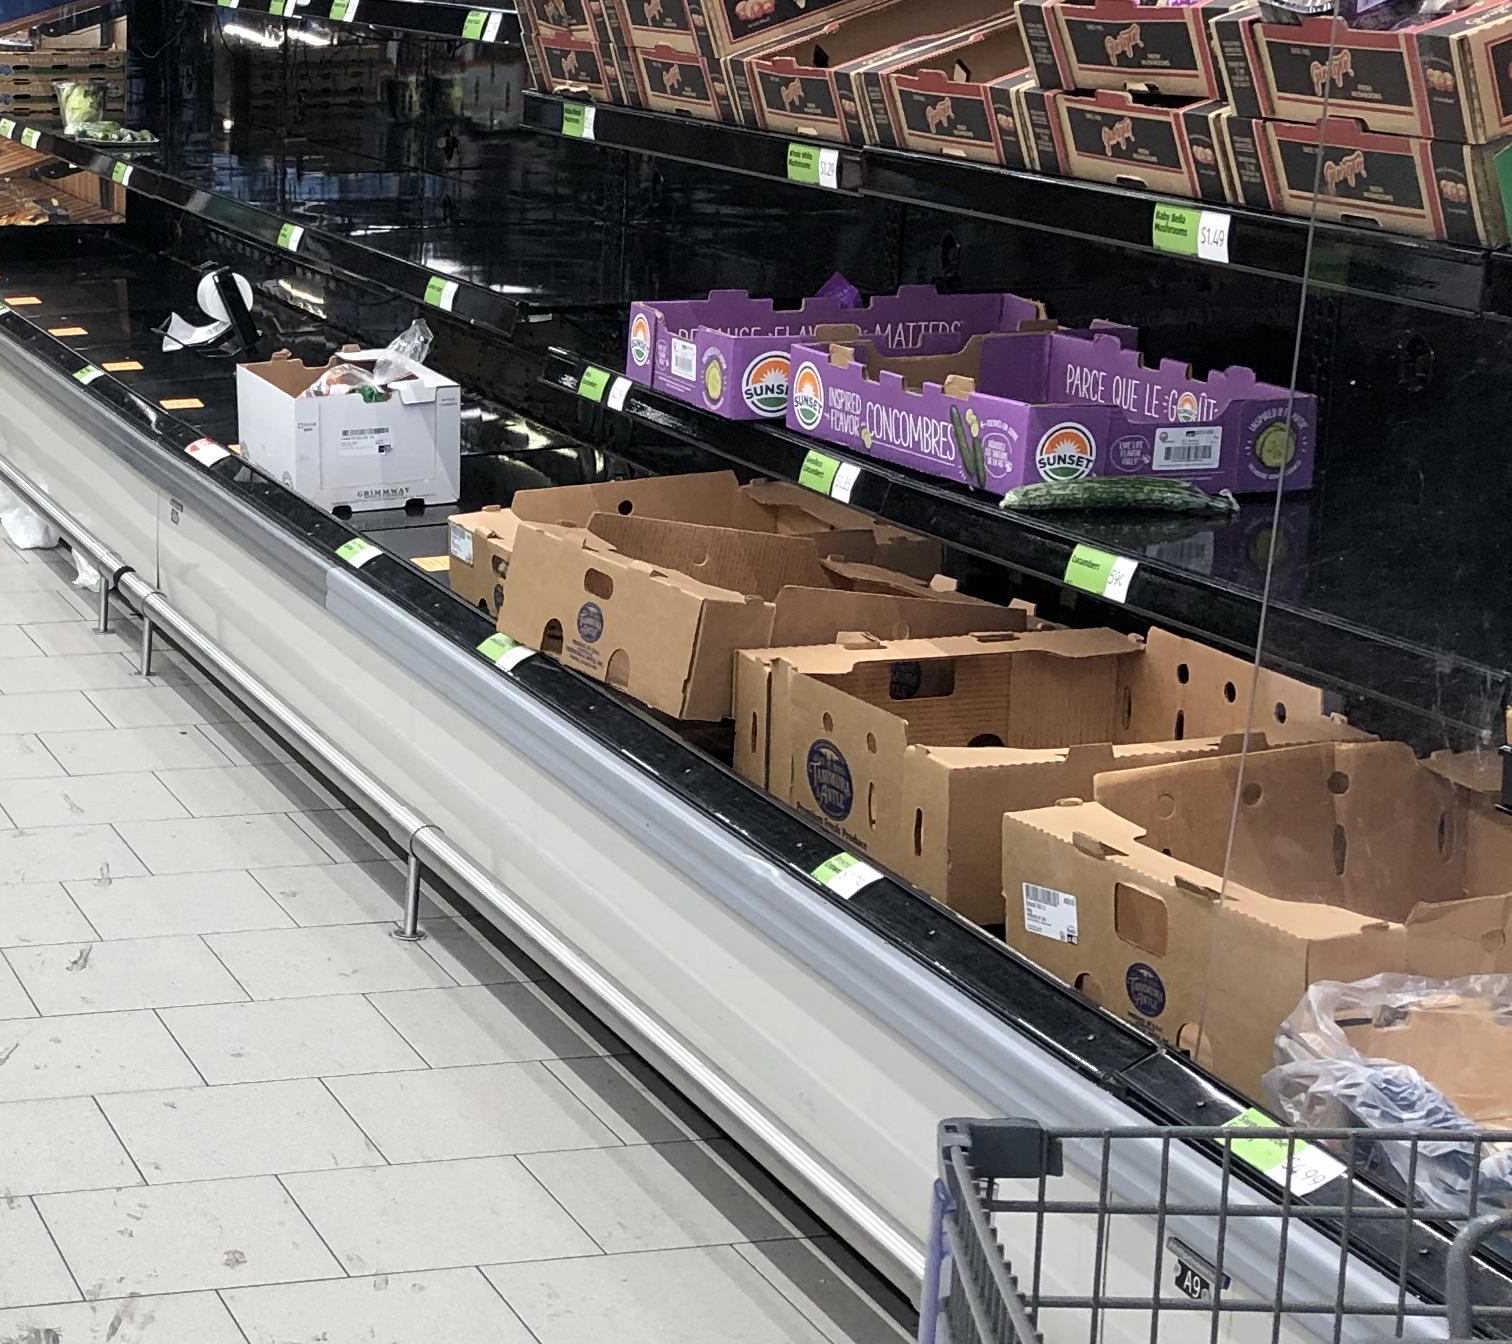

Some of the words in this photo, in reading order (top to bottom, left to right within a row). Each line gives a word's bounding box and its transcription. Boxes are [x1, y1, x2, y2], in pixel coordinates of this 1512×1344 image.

[1201, 226, 1225, 247] $1.49
[745, 383, 790, 400] SUNS
[828, 387, 862, 415] INSPIRED
[1065, 363, 1108, 404] PARCE
[1112, 375, 1140, 413] QUE
[1144, 382, 1162, 419] LE
[794, 395, 823, 414] SUNSET
[830, 408, 860, 438] FLAVOR
[866, 401, 956, 460] CONCOMBRES
[1037, 454, 1094, 470] SUNSET
[357, 487, 410, 498] GRIMMWAY
[1183, 1270, 1201, 1298] A9
